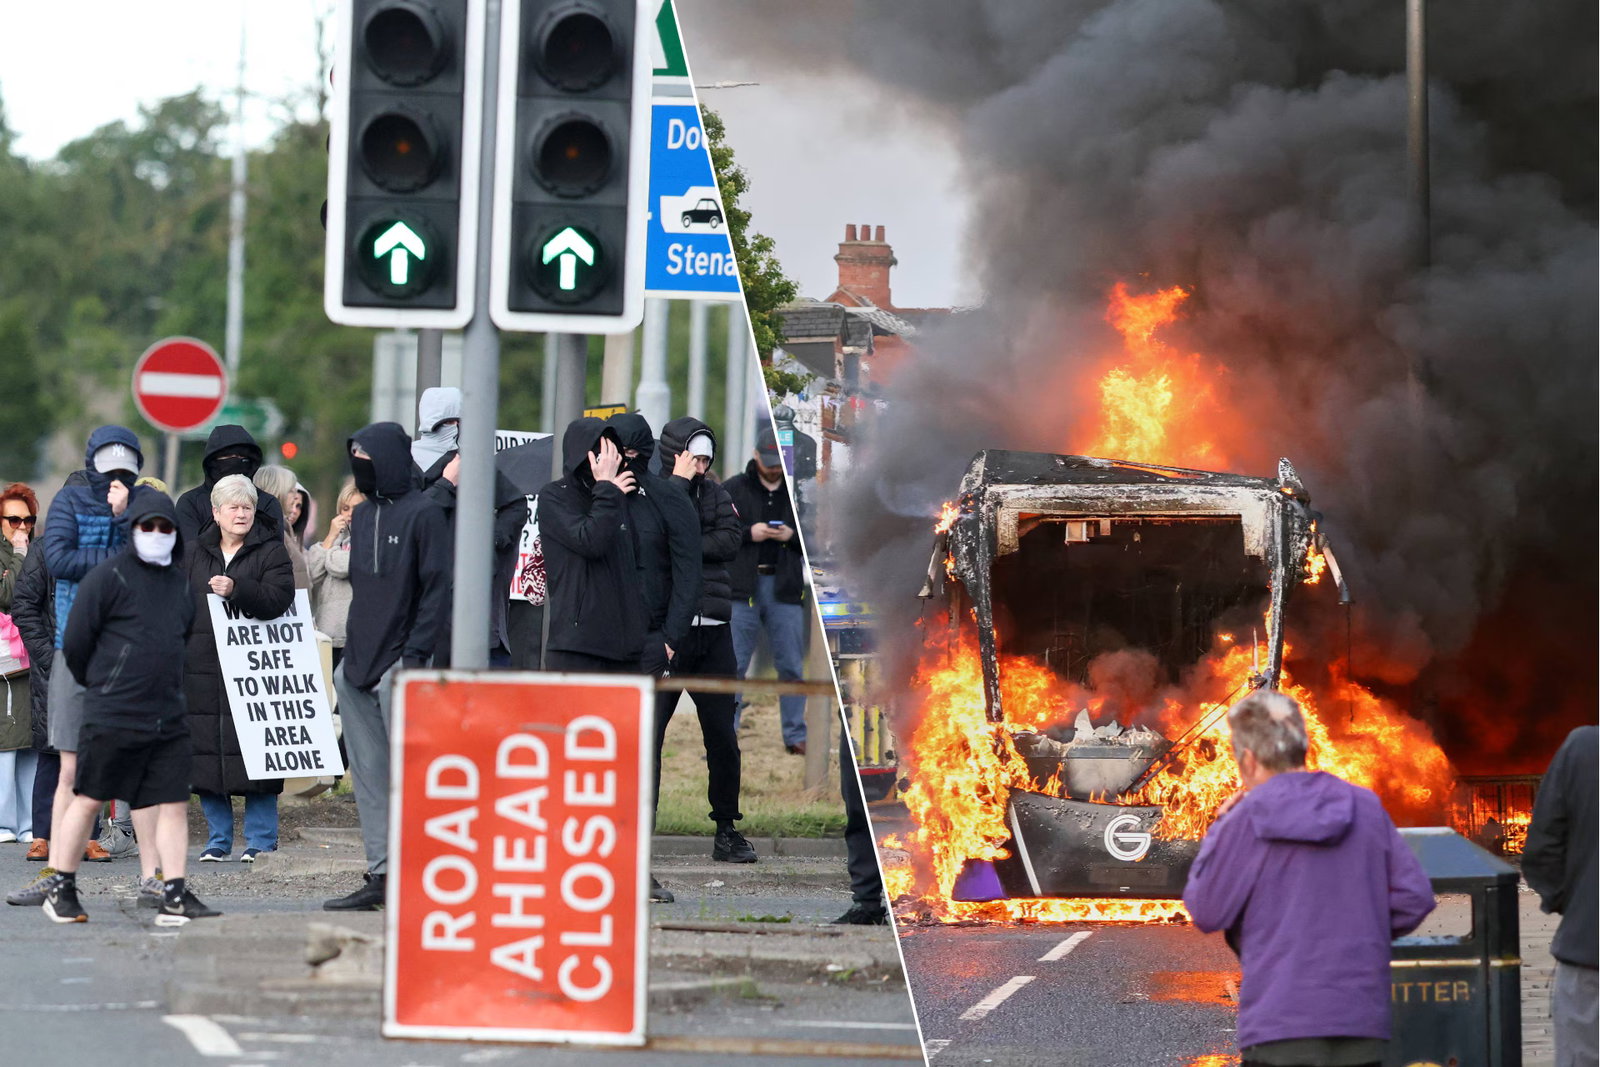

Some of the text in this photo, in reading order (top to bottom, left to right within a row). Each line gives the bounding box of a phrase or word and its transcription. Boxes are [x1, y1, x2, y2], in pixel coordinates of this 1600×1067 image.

[666, 243, 736, 276] Stena
[227, 622, 304, 646] ARE NOT
[247, 649, 294, 671] SAFE
[233, 673, 318, 697] TO WALK
[246, 699, 316, 722] IN THIS
[264, 725, 313, 747] AREA
[265, 750, 325, 772] ALONE
[421, 754, 480, 951] ROAD
[490, 733, 549, 982] AHEAD
[557, 715, 617, 1002] CLOSED
[1391, 981, 1470, 1002] ITTER
